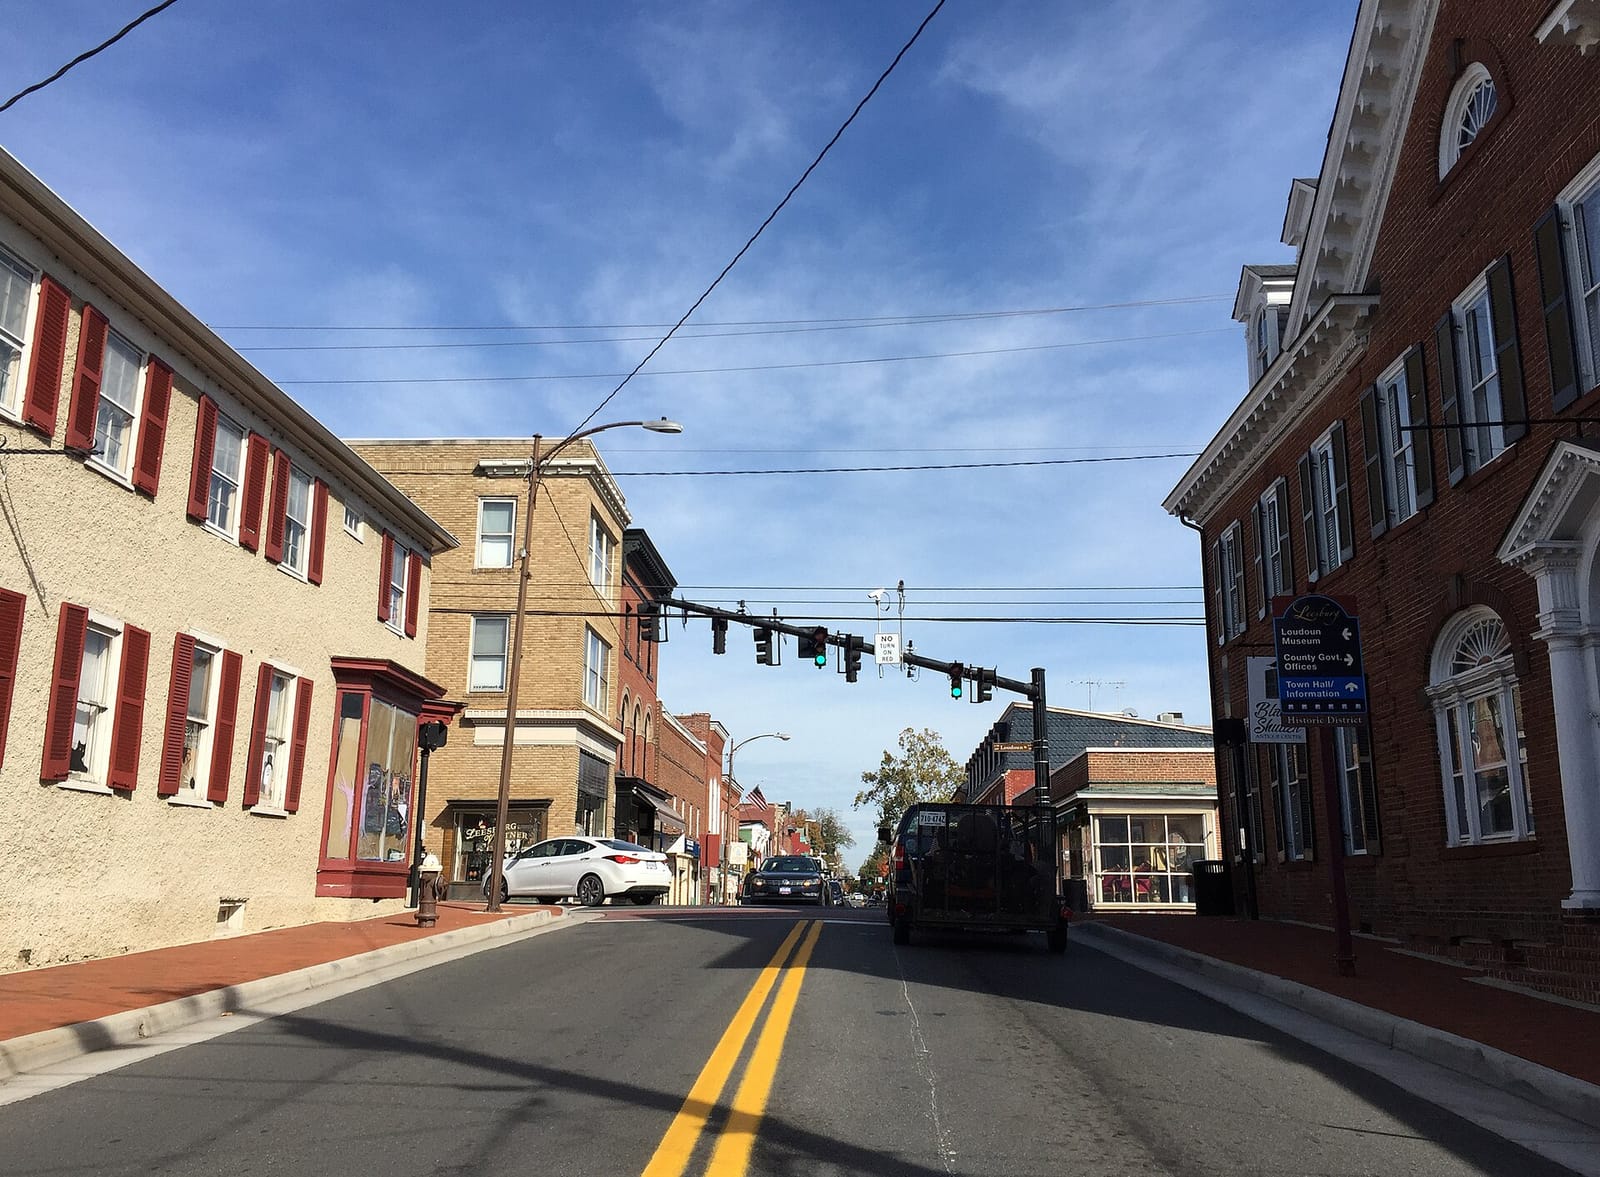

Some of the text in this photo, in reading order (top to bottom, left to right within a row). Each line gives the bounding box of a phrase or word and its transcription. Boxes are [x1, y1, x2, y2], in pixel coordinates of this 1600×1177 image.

[1281, 628, 1322, 636] Loudoun
[1282, 637, 1321, 645] Museum
[1283, 653, 1343, 663] County Govt.
[1284, 663, 1317, 671] Offices
[1286, 679, 1334, 689] Town Hall/
[1286, 690, 1340, 698] Information
[1287, 716, 1362, 725] Historic District
